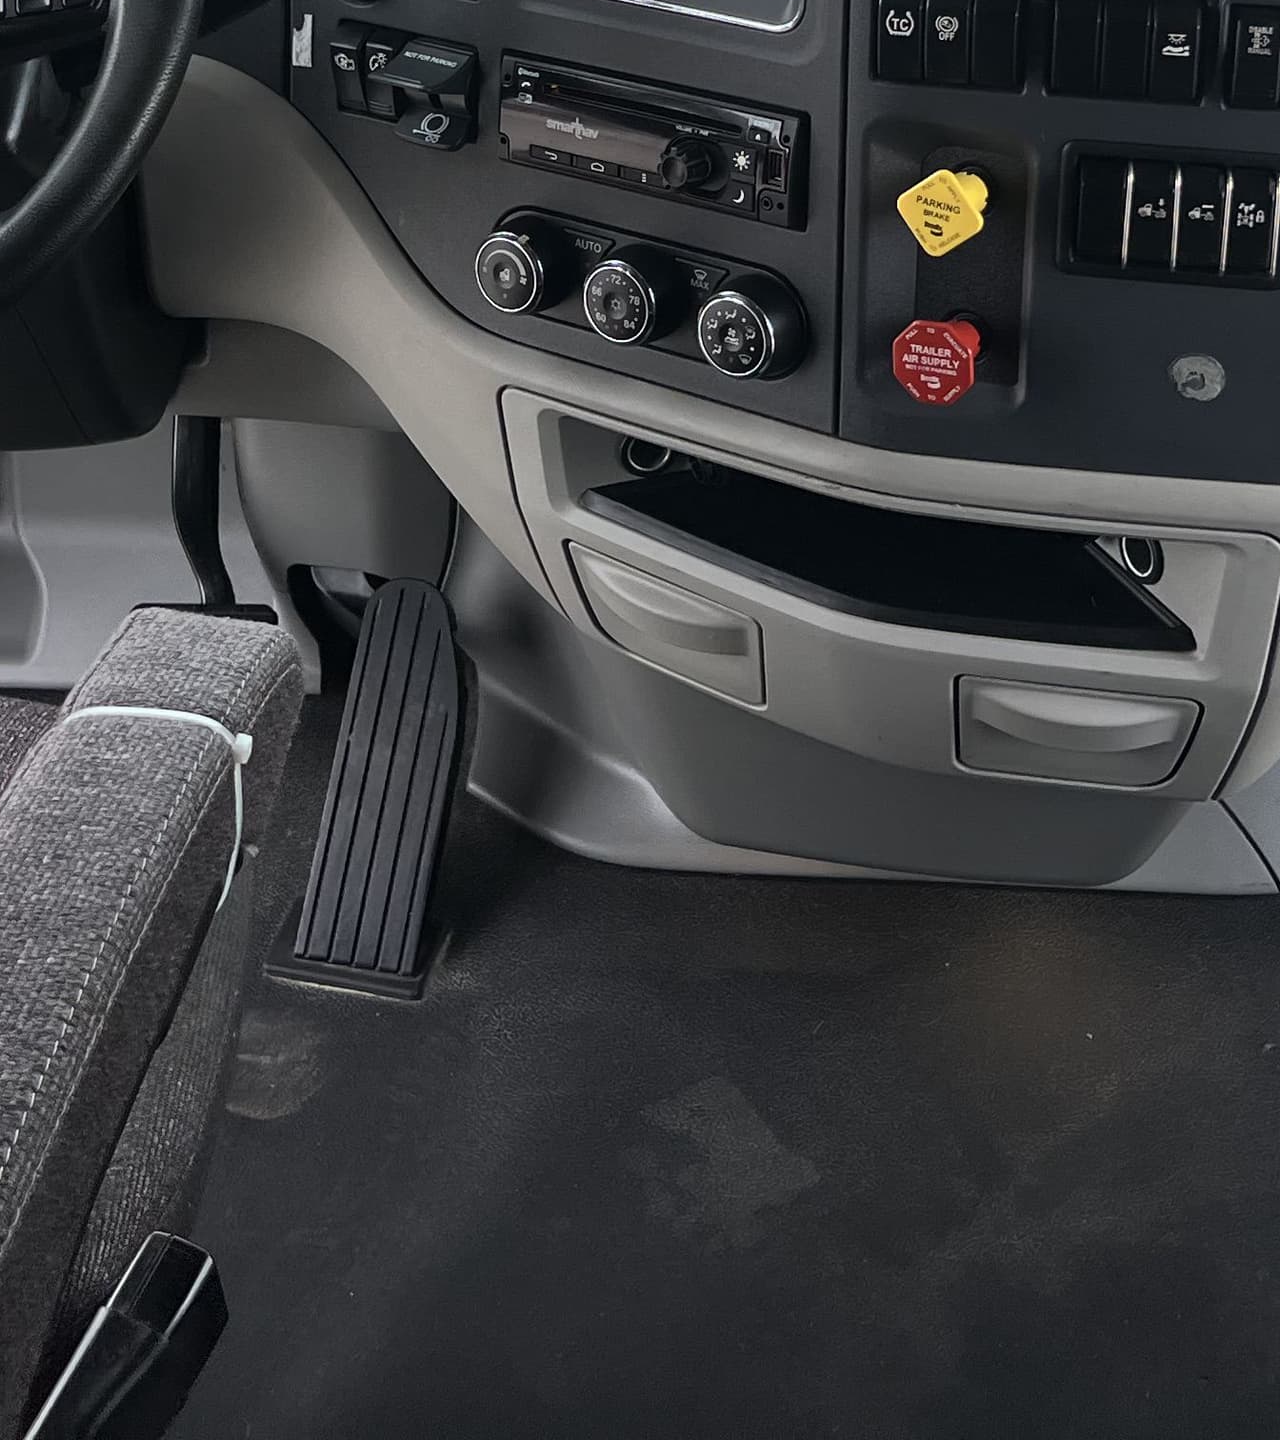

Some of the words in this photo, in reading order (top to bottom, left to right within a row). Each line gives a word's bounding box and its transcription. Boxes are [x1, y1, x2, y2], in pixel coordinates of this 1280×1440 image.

[891, 18, 909, 31] TC
[939, 31, 955, 41] OFF
[916, 195, 960, 214] PARKING
[923, 209, 950, 222] BRAKE
[575, 238, 602, 253] AUTO
[610, 274, 621, 285] 72
[690, 279, 709, 290] MAX
[629, 296, 640, 305] 78
[595, 312, 607, 323] 60
[624, 320, 635, 330] 84
[910, 344, 951, 358] TRAILER
[902, 354, 918, 363] AIR
[921, 357, 960, 369] SUPPLY
